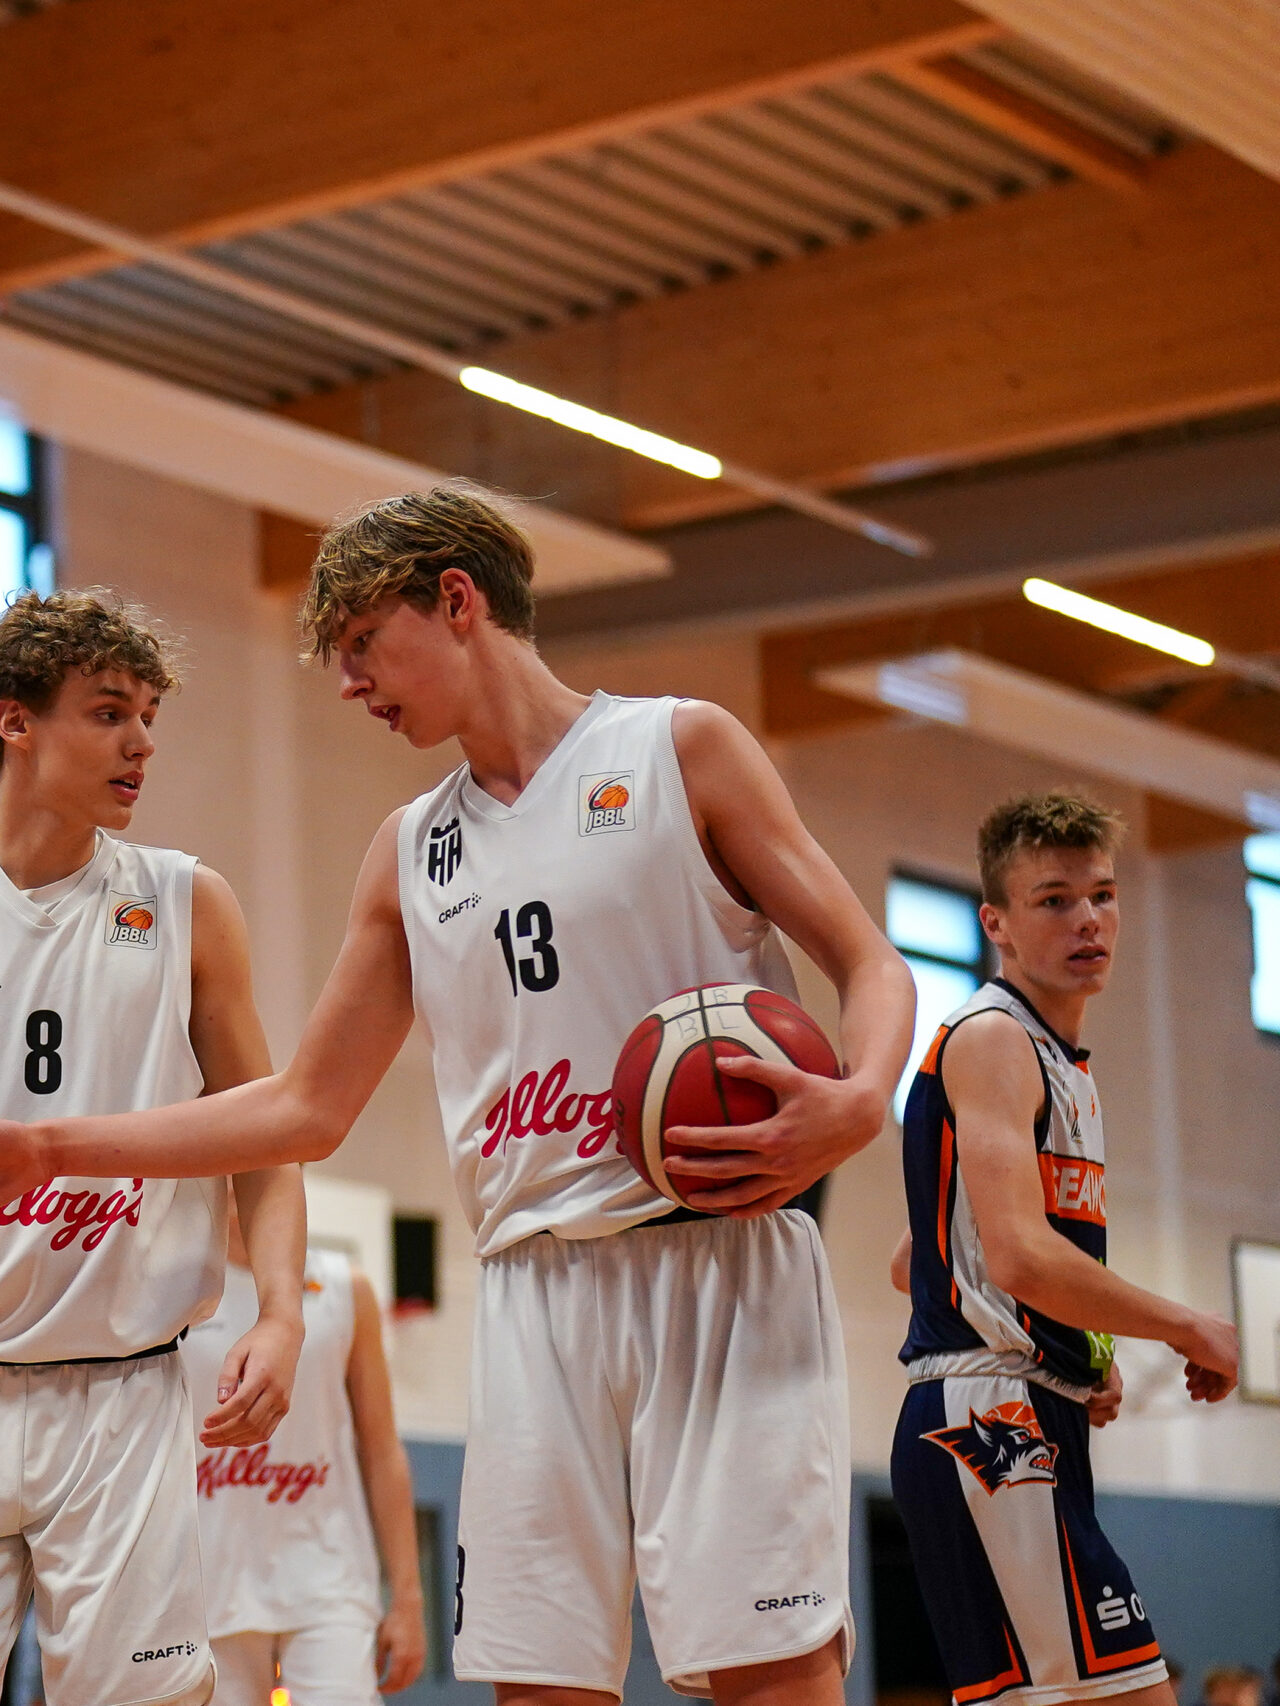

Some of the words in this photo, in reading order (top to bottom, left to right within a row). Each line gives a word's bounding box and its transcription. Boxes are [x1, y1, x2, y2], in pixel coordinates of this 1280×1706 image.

[585, 807, 626, 833] JBBL
[438, 897, 471, 924] CRAFT
[110, 925, 149, 945] JBBL
[494, 900, 560, 998] 13
[24, 1009, 63, 1096] 8
[754, 1593, 811, 1612] CRAFT
[131, 1644, 185, 1664] CRAFT
